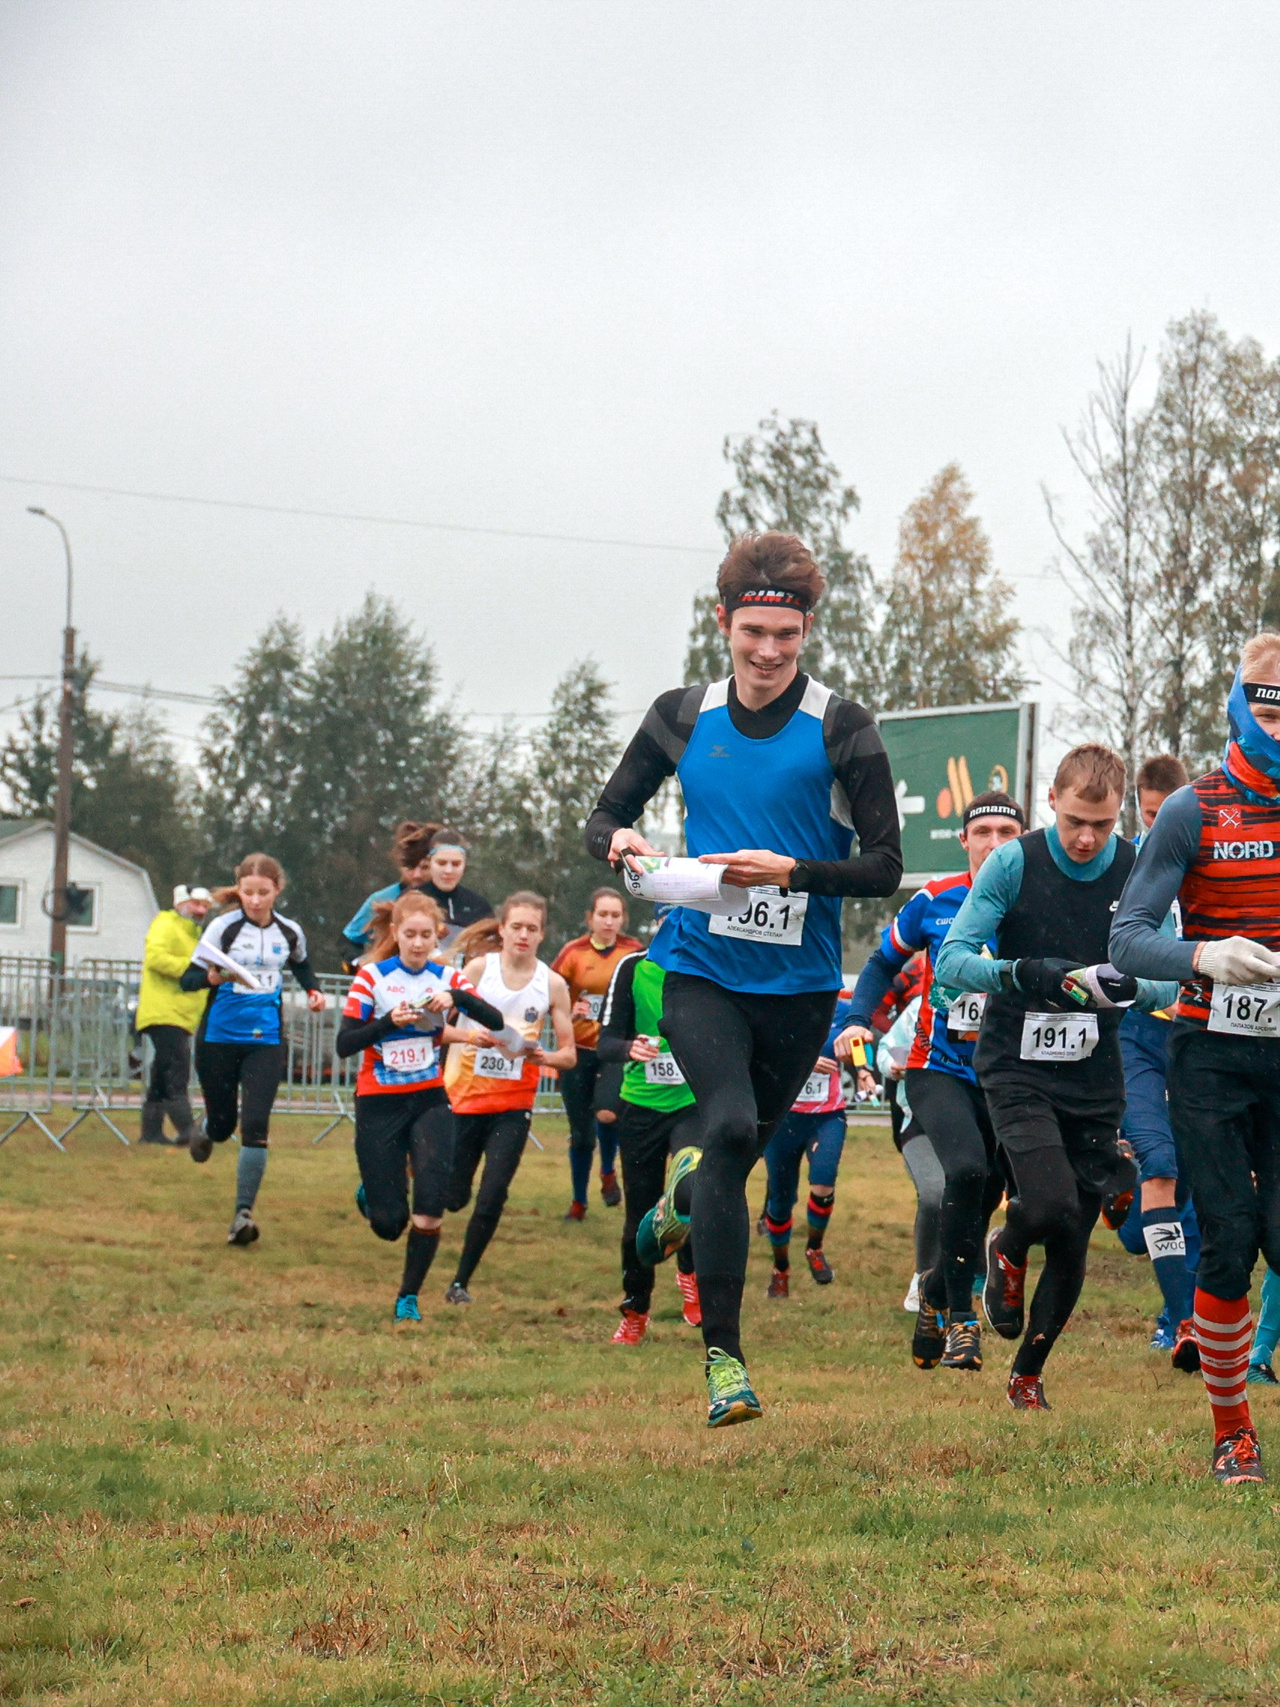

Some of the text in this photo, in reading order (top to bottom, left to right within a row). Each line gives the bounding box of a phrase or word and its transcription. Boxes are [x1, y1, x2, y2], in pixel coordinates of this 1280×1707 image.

[1213, 840, 1274, 859] NORD
[726, 925, 763, 936] АЛЕКСАНДРОВ
[1032, 1027, 1087, 1049] 191.1
[390, 1047, 427, 1065] 219.1
[480, 1055, 515, 1072] 230.1
